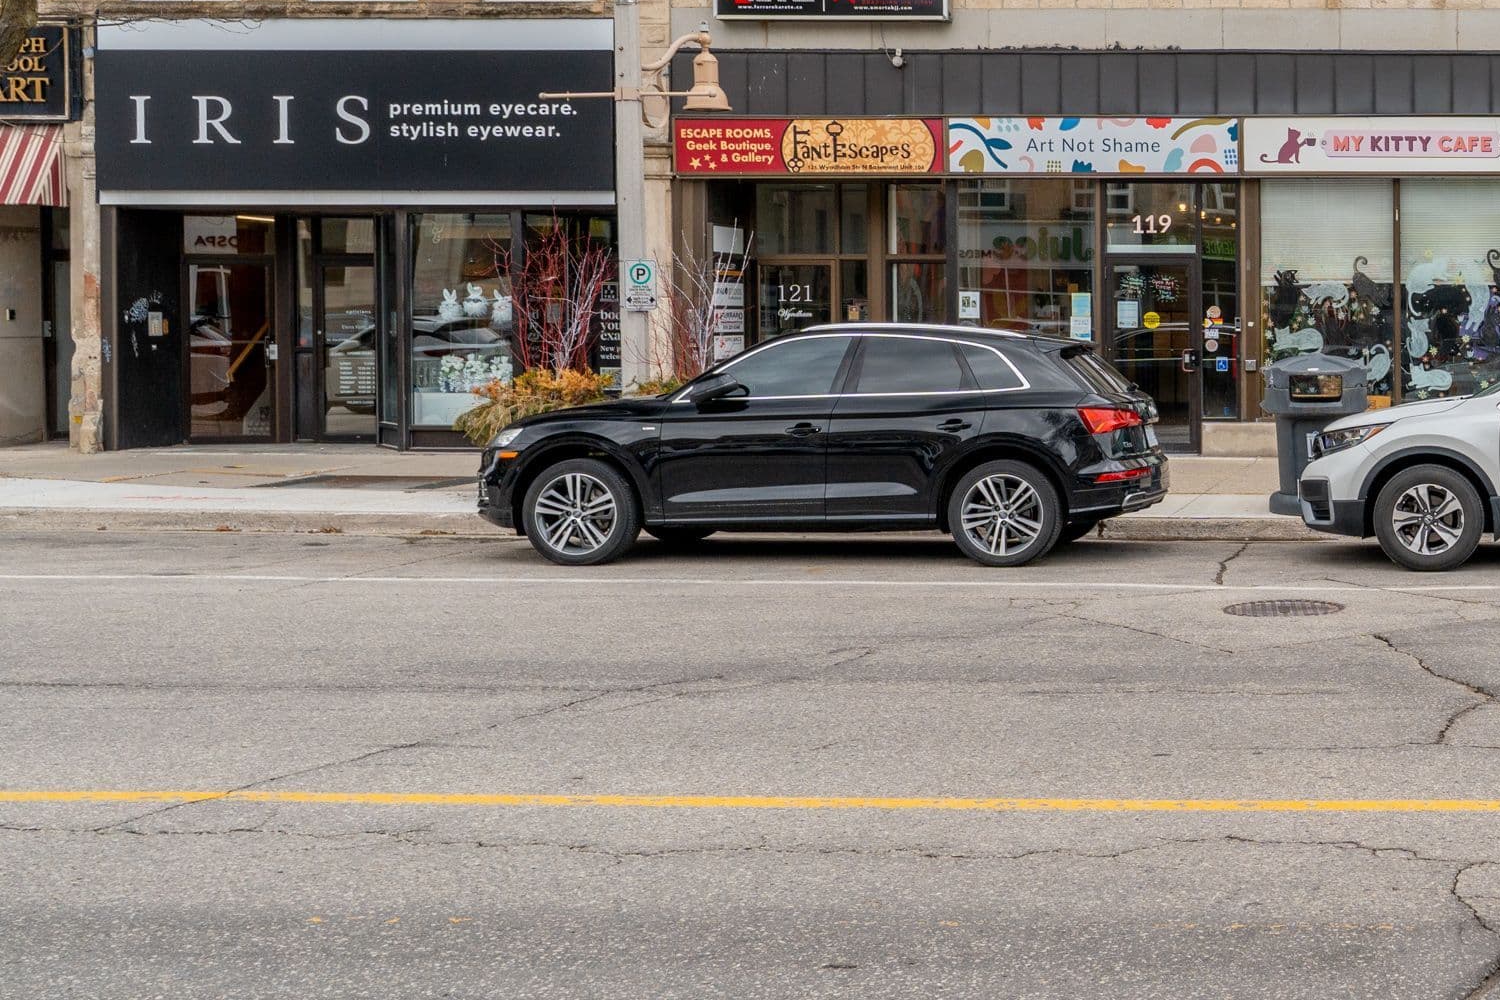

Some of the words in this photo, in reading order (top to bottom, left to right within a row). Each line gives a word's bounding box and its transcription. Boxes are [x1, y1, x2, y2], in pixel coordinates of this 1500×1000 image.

[389, 100, 481, 119] premium
[489, 103, 578, 119] eyecare.
[129, 95, 370, 145] IRIS
[389, 121, 459, 140] stylish
[467, 125, 561, 141] eyewear.
[680, 128, 723, 139] ESCAPE
[686, 140, 717, 151] Geek
[1026, 138, 1054, 153] Art
[1062, 138, 1095, 153] Not
[1102, 138, 1161, 153] Shame
[1333, 135, 1364, 152] MY
[1370, 135, 1431, 152] KITTY
[1437, 135, 1493, 153] CAFE
[720, 153, 729, 163] &
[731, 152, 775, 165] Gallery
[1131, 214, 1172, 234] 119
[636, 267, 646, 280] P
[777, 284, 814, 302] 121
[600, 322, 620, 331] you
[600, 331, 620, 341] exa
